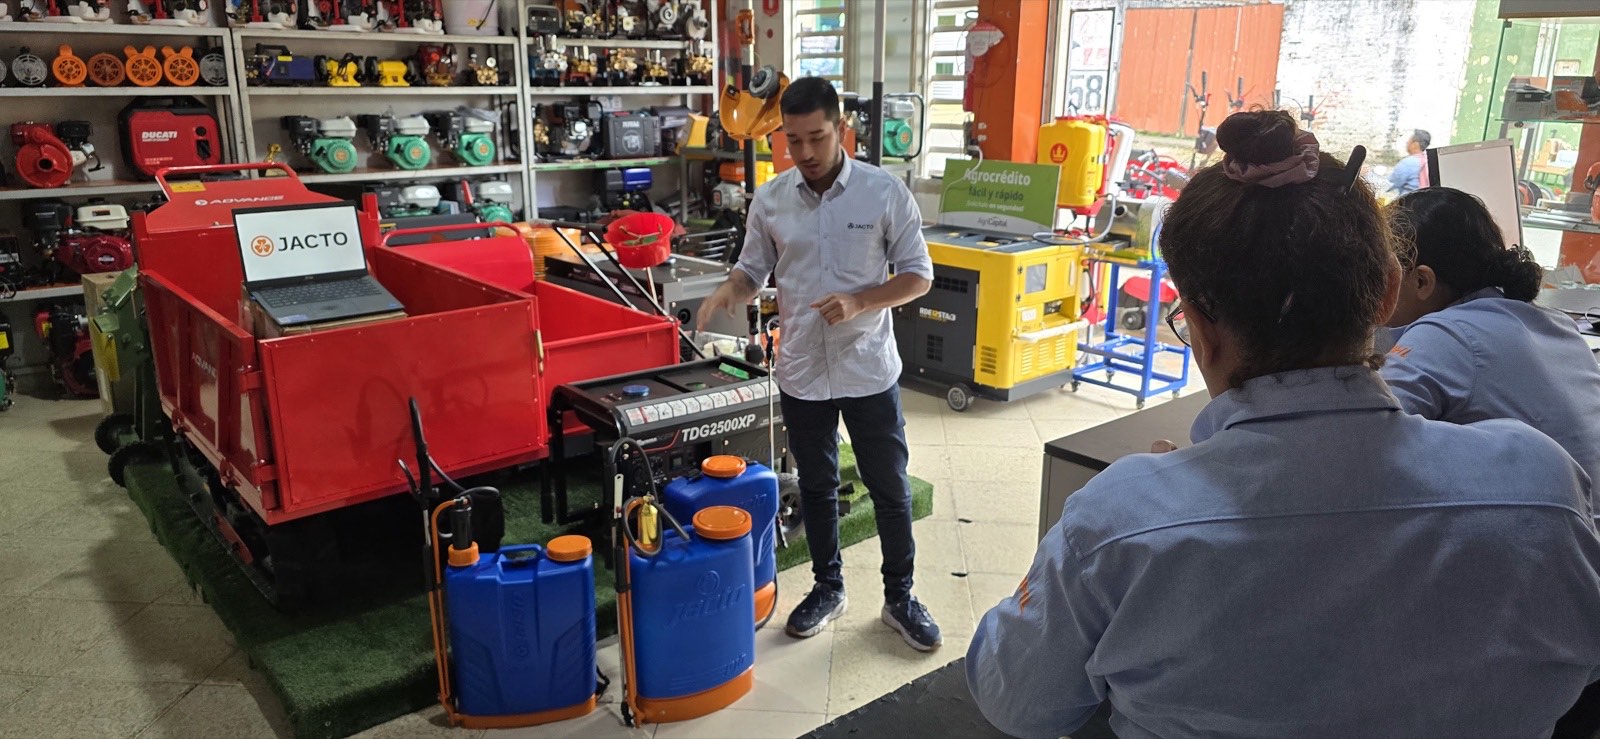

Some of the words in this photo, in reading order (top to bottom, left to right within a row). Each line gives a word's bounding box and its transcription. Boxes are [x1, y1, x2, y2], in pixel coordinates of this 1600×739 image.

[1069, 74, 1103, 111] 58
[142, 131, 178, 139] DUCATI
[964, 168, 1031, 186] Agrocrédito
[209, 195, 284, 205] ADVANCE
[968, 186, 987, 197] fácil
[988, 190, 994, 200] y
[995, 190, 1024, 202] rápido
[278, 231, 348, 252] JACTO
[682, 413, 756, 442] TDG2500XP
